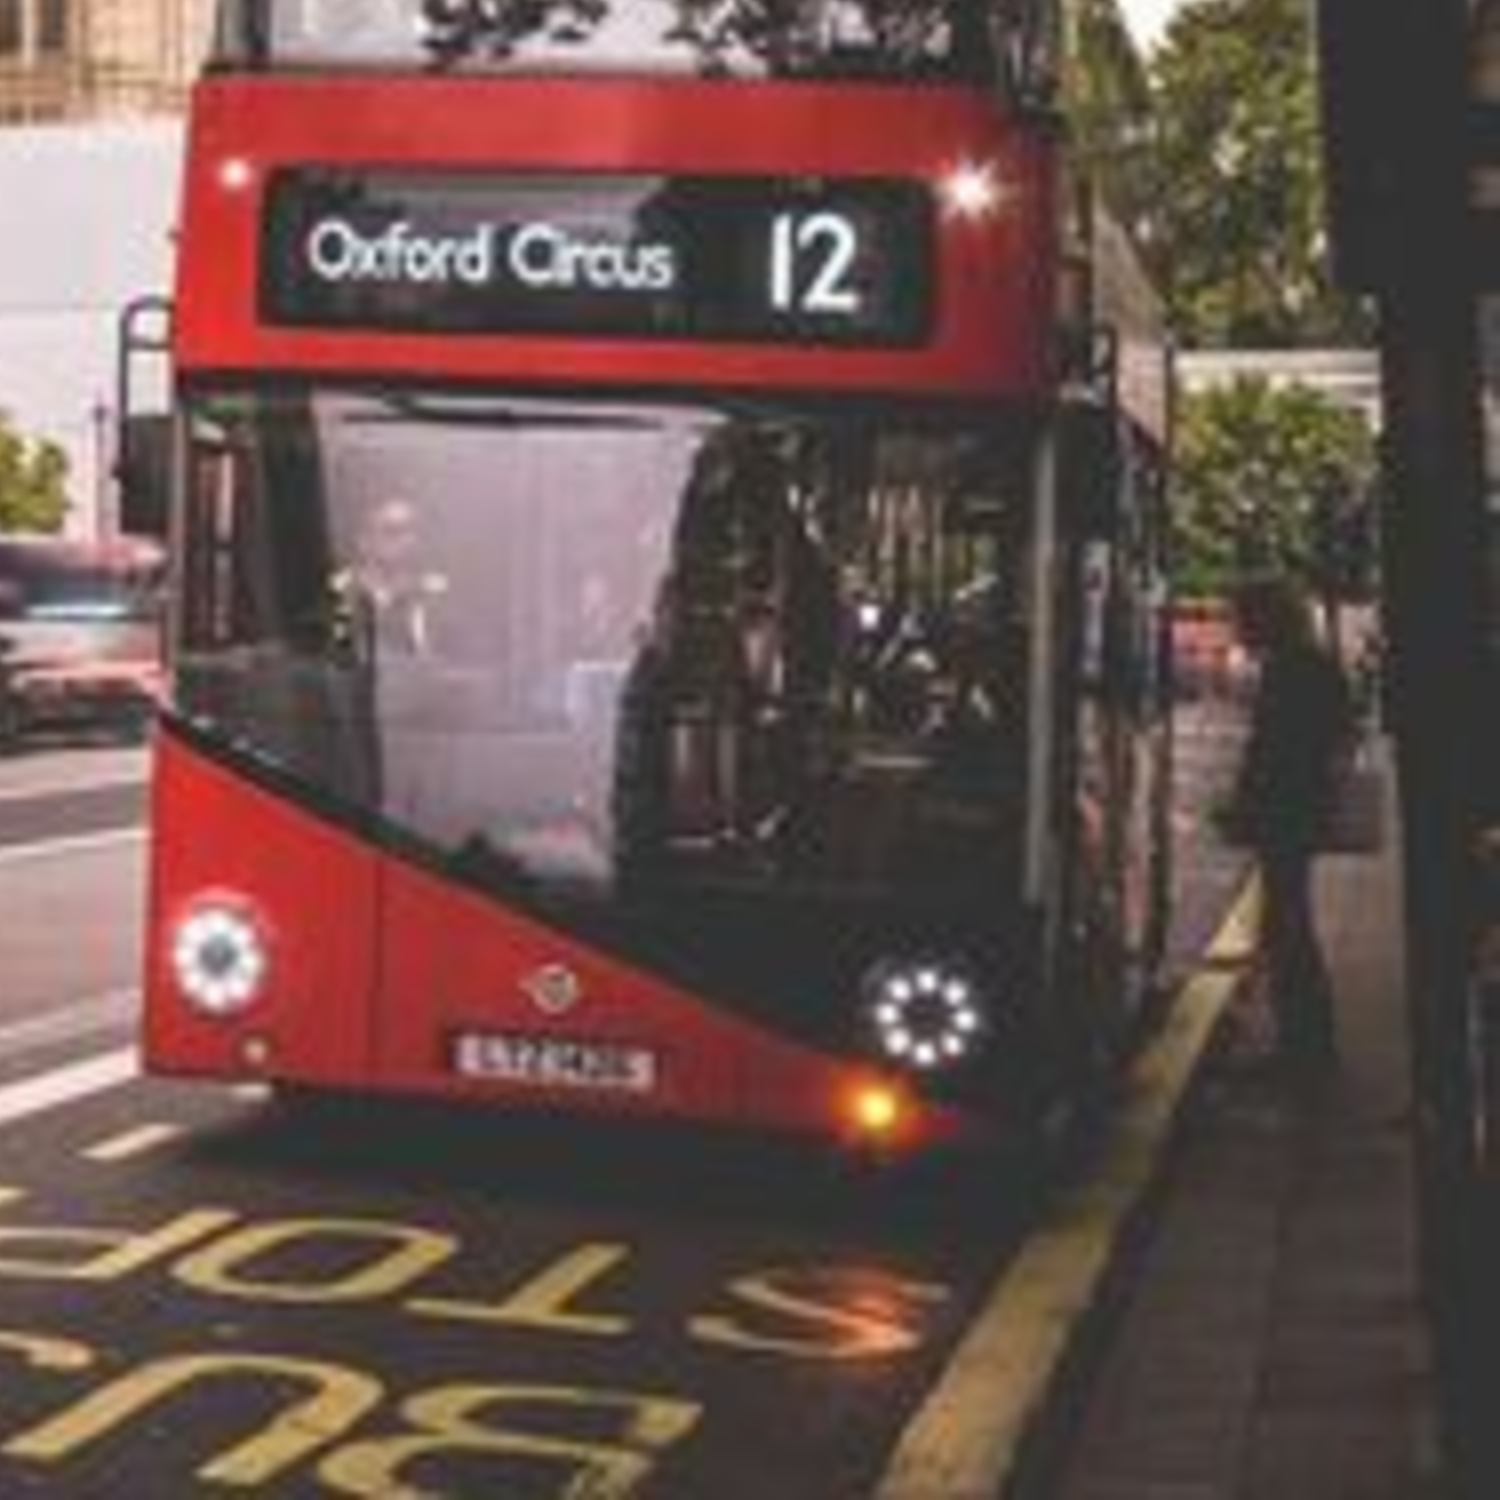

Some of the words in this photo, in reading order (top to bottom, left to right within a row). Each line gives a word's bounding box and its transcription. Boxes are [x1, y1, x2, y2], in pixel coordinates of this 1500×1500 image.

[308, 218, 494, 284] Oxford
[509, 221, 674, 290] Circus
[768, 212, 860, 313] 12
